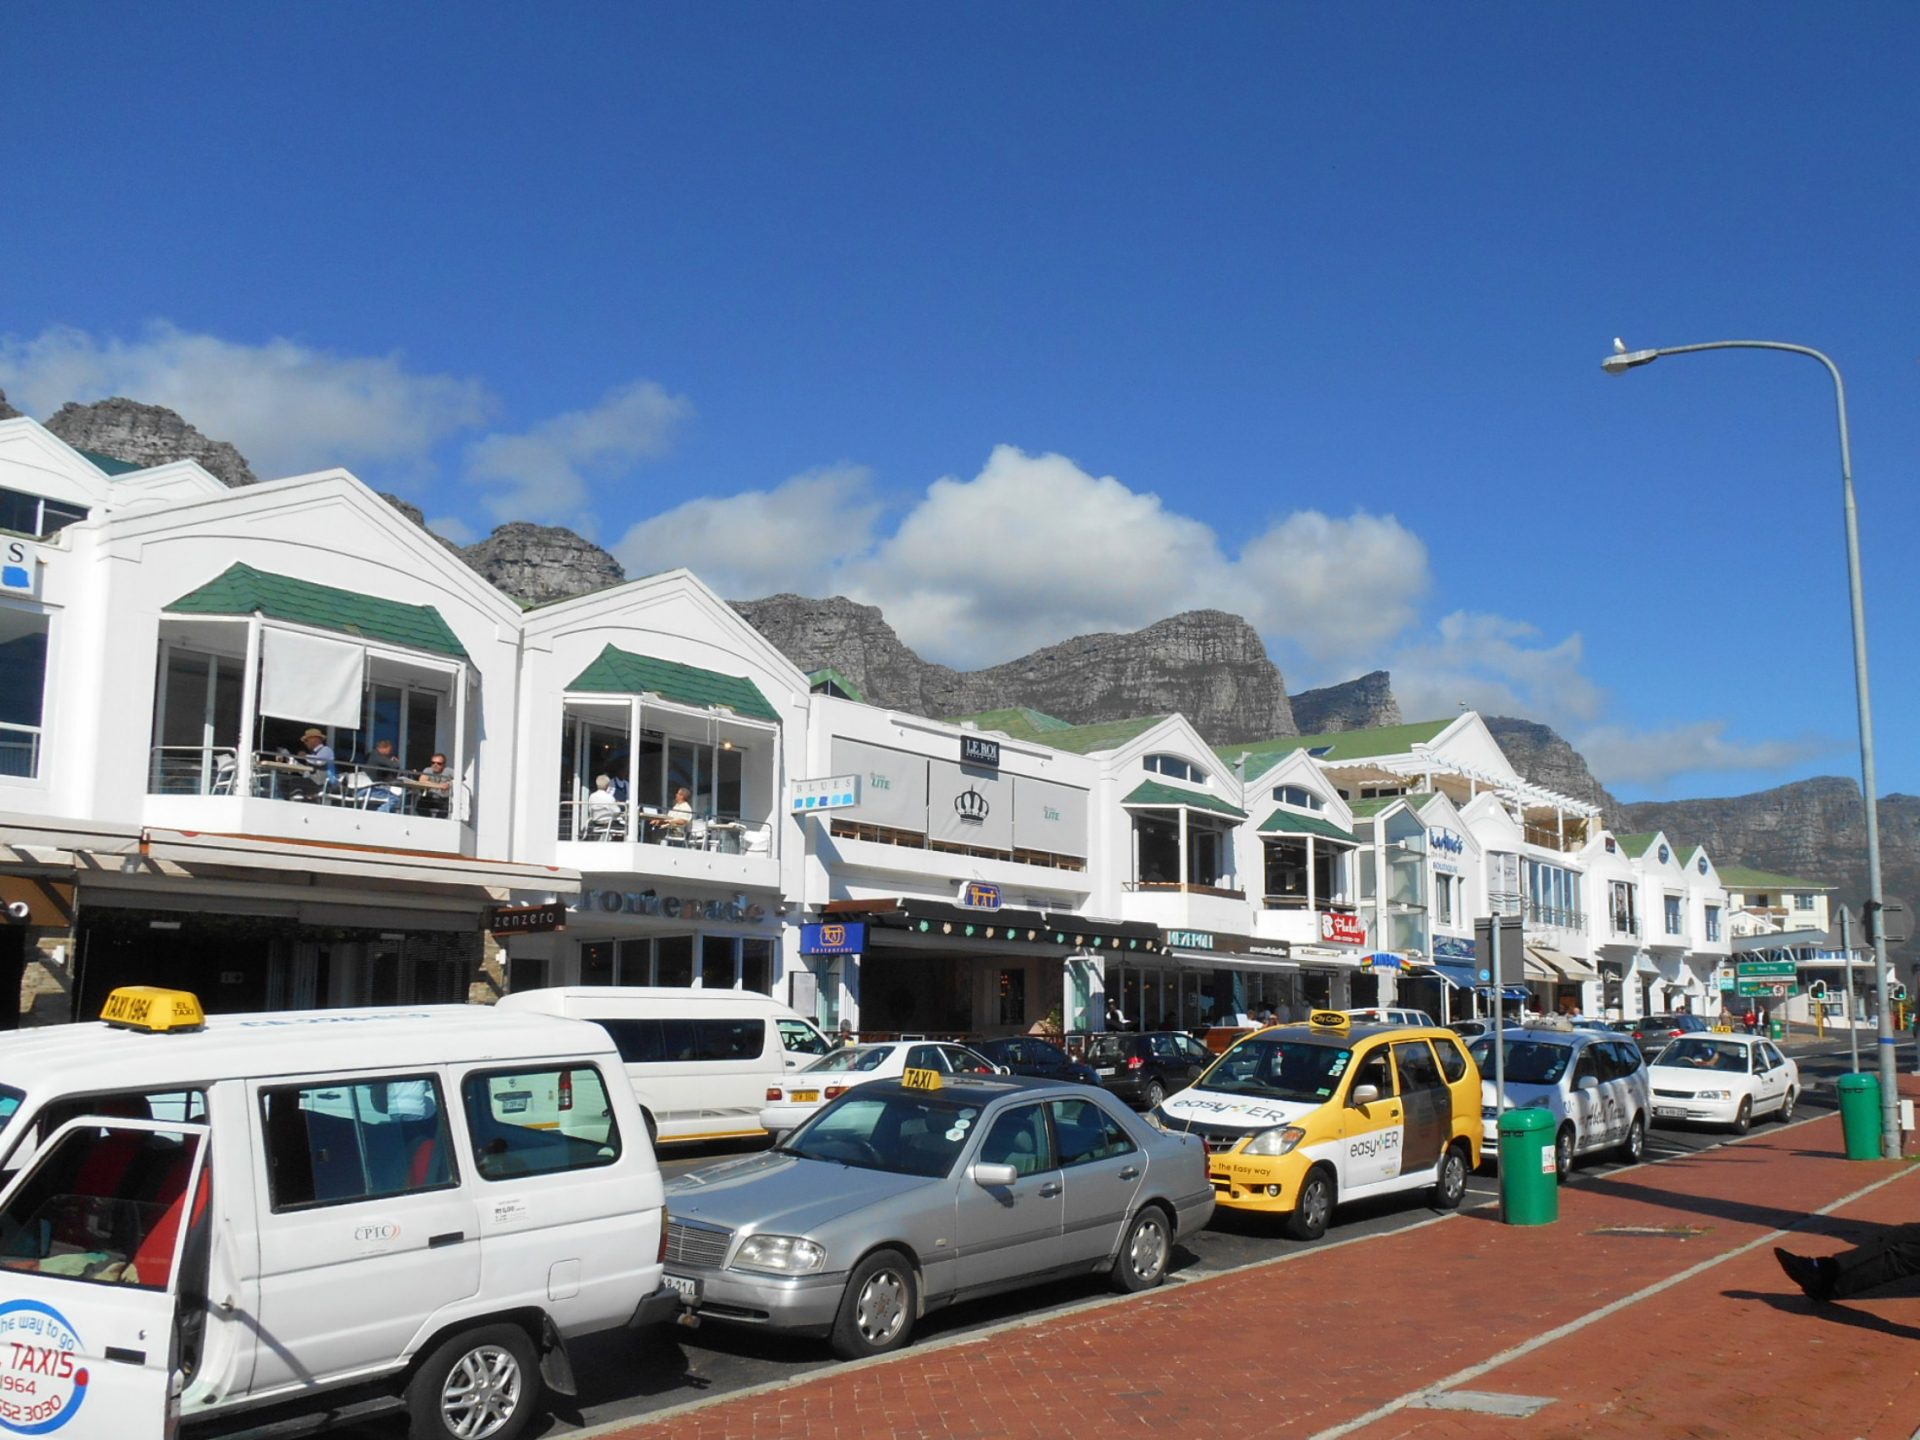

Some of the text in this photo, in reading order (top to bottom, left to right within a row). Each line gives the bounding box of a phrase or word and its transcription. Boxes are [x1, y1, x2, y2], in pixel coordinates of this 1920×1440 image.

[966, 739, 979, 755] LE
[980, 743, 997, 758] ROI
[796, 778, 852, 792] BLUES
[494, 911, 554, 928] zenzero
[106, 995, 151, 1021] TAXI 1964
[176, 1001, 187, 1009] EL
[907, 1069, 933, 1089] TAXI
[1218, 1163, 1272, 1177] the Easy way
[19, 1317, 45, 1335] way
[47, 1320, 59, 1338] to
[60, 1333, 75, 1351] go
[10, 1342, 75, 1378] TAXIS
[24, 1395, 62, 1421] 3030
